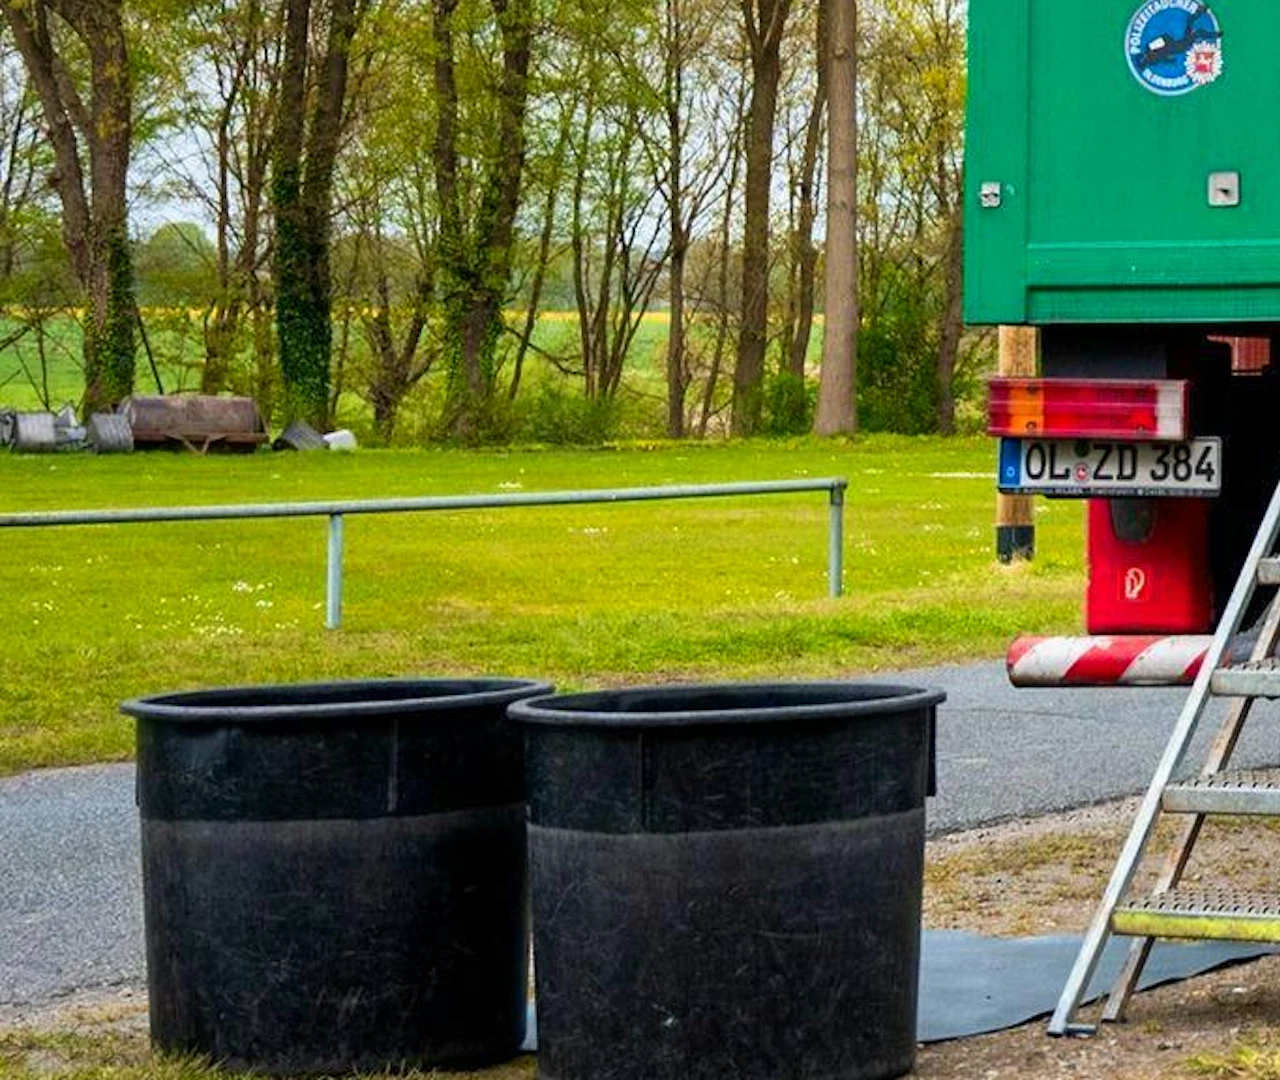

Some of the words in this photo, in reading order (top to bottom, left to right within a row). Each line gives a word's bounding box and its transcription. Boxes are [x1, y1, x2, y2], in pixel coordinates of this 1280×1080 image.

[1025, 443, 1070, 480] OL
[1092, 443, 1138, 482] ZD
[1150, 445, 1216, 482] 384
